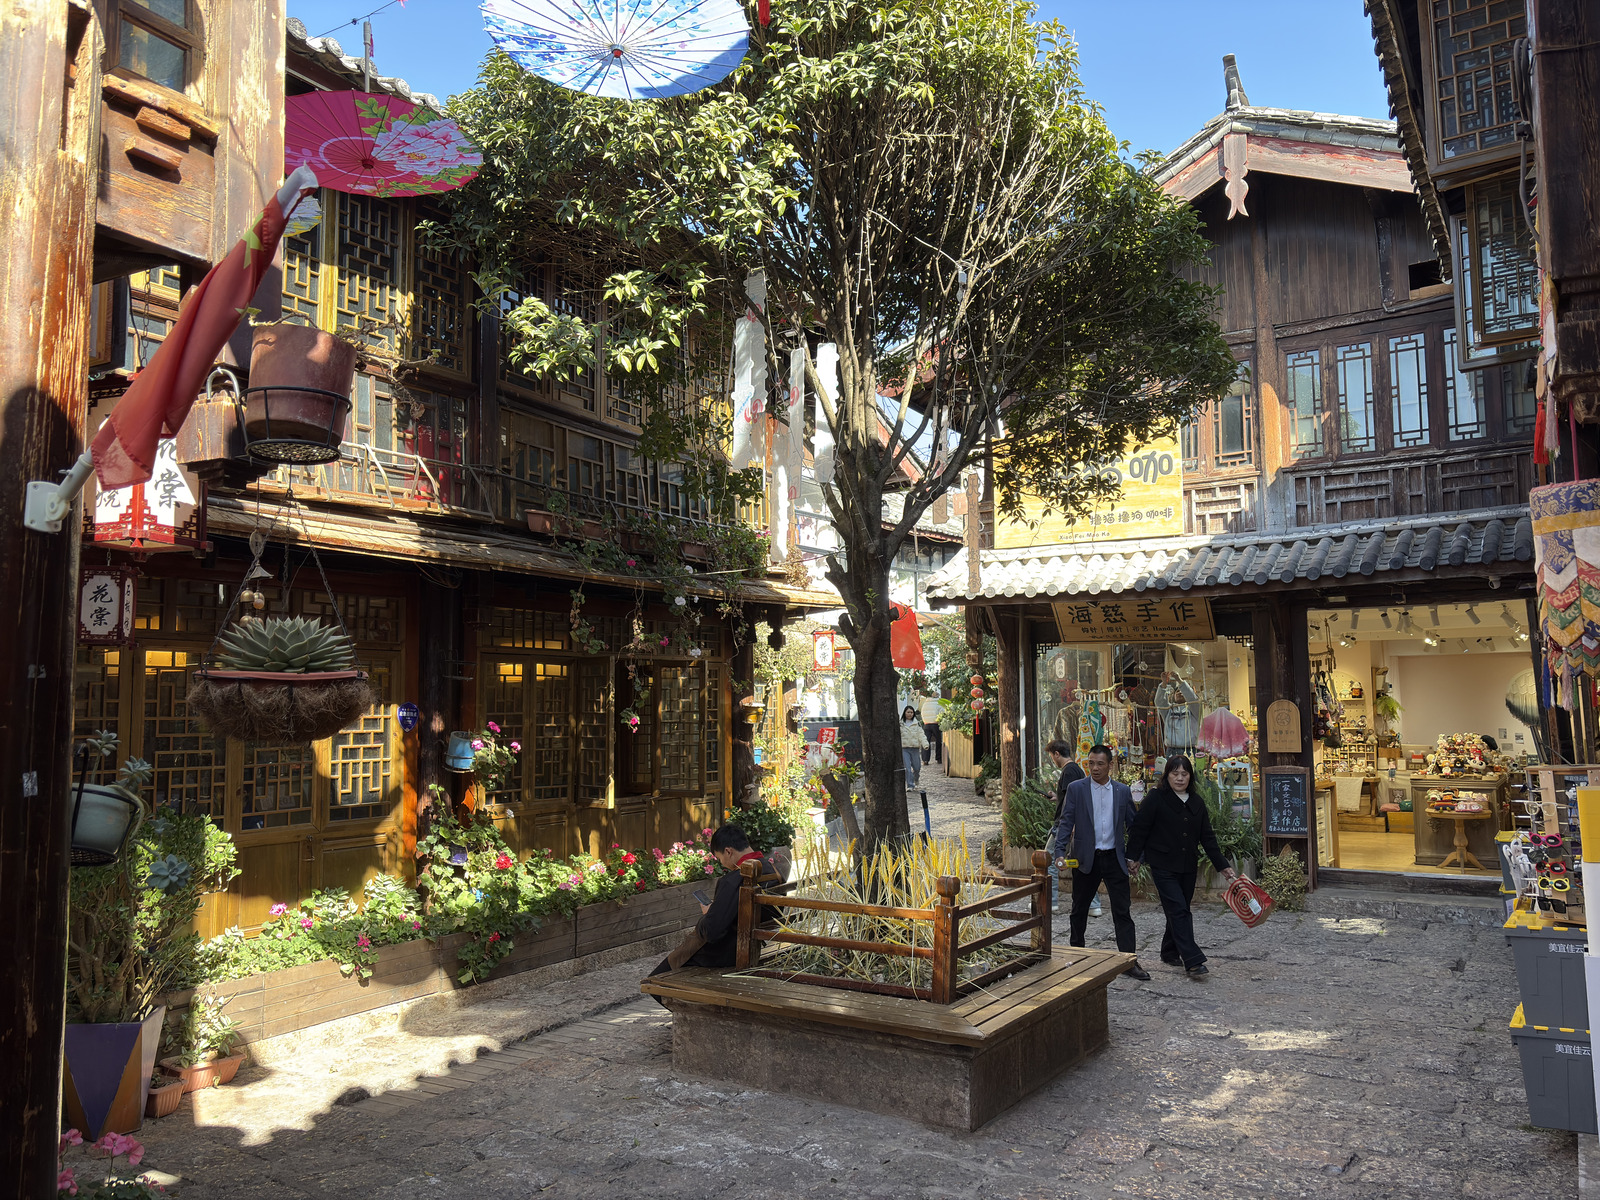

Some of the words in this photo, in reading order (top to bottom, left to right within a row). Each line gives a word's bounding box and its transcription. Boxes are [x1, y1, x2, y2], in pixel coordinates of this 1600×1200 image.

[89, 583, 113, 627] 花棠
[1068, 601, 1196, 624] 海慈手作
[1281, 780, 1292, 816] 一家文艺的
[1270, 816, 1301, 826] 手作店
[1555, 1044, 1591, 1055] 美宜佳云
